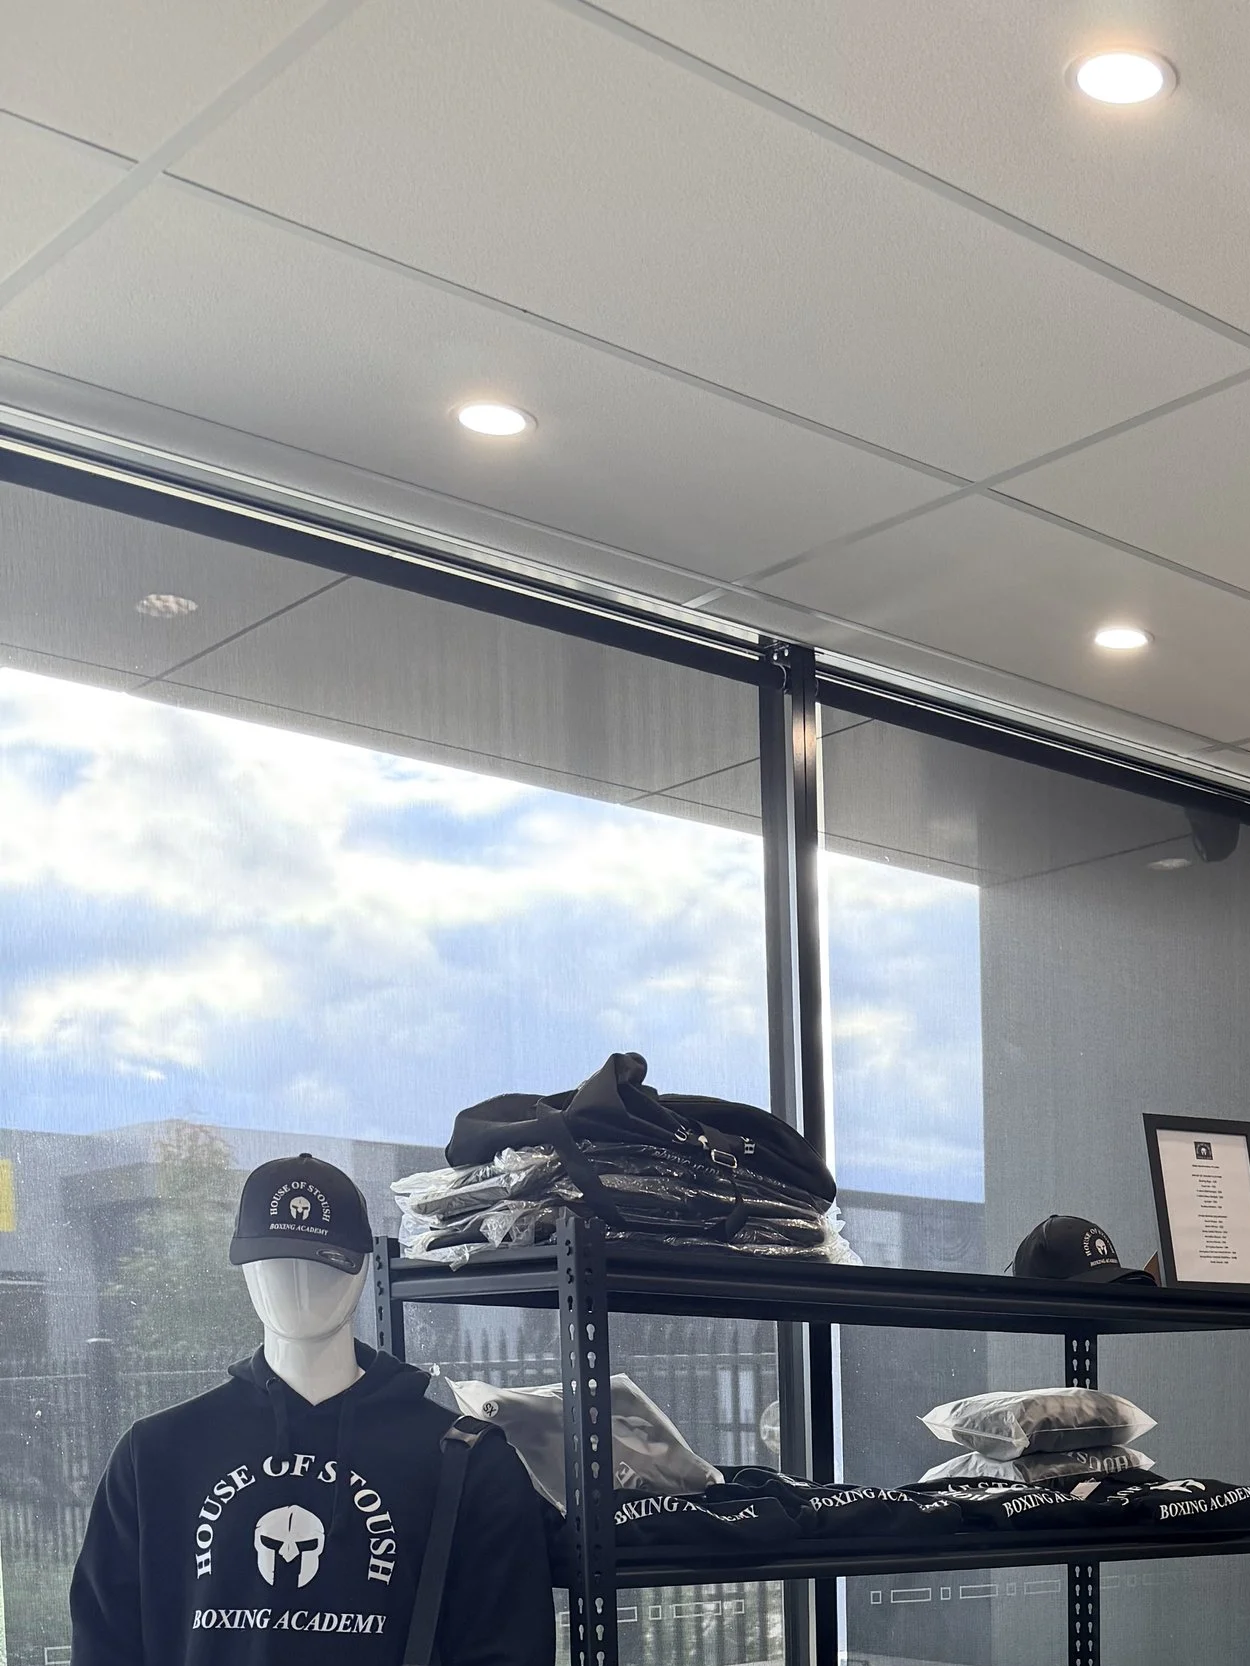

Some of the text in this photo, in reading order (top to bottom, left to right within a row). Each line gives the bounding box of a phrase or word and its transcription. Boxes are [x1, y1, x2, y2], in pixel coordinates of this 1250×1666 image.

[270, 1181, 331, 1222] HOUSE OF STOUSH
[269, 1223, 329, 1236] BOXING ACADEMY
[613, 1496, 759, 1525] BOXING AEMY
[810, 1488, 875, 1511] BOXING
[878, 1488, 950, 1513] ACAMY
[1002, 1494, 1053, 1517] BOXING
[1160, 1499, 1208, 1520] BOXING
[195, 1453, 396, 1586] HOUSE OF STOUSH
[193, 1609, 387, 1634] BOXING ACADEMY
